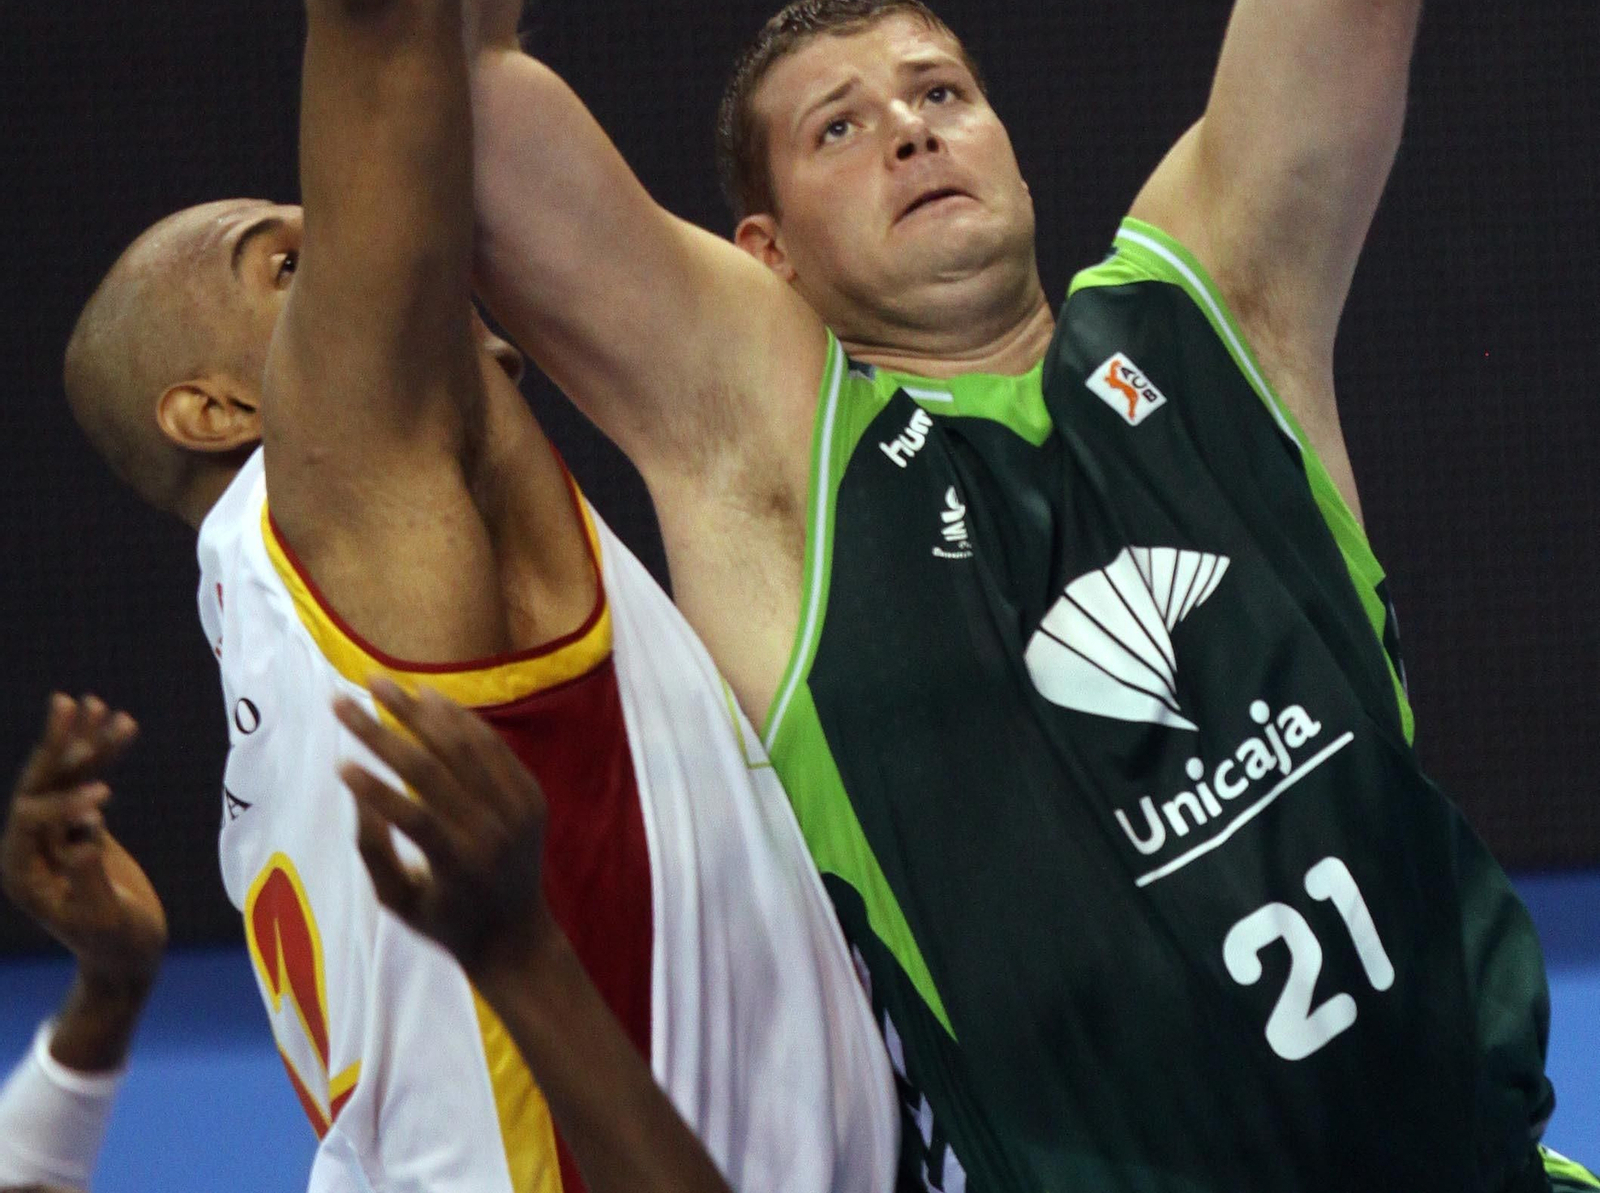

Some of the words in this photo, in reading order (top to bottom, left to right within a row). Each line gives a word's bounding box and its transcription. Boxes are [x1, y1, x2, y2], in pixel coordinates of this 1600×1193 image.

[1120, 367, 1158, 403] ACB
[1114, 699, 1322, 854] Unicaja
[1222, 856, 1396, 1061] 21
